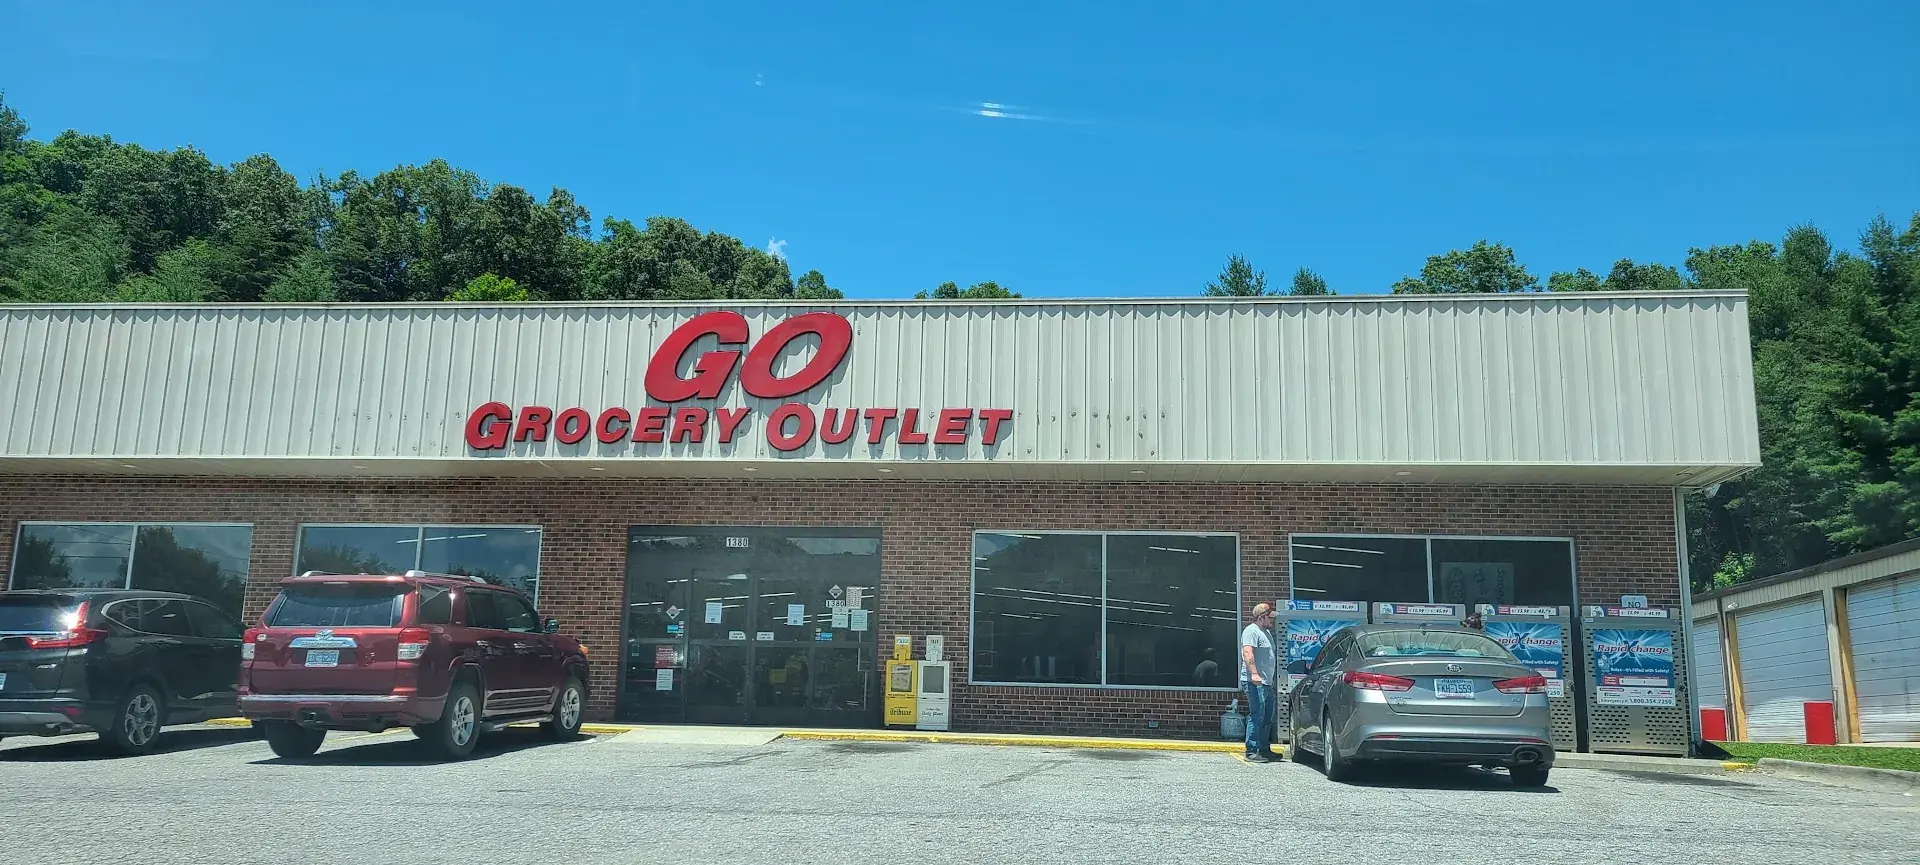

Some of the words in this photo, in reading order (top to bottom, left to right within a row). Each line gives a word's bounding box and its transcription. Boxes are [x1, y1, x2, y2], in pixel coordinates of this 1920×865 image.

[644, 310, 853, 402] GO
[466, 401, 751, 451] GROCERY
[765, 402, 1012, 451] OUTLET
[727, 537, 748, 547] 1380
[1291, 634, 1319, 643] Rapid
[1498, 638, 1518, 646] apid
[1597, 644, 1628, 653] Rapid
